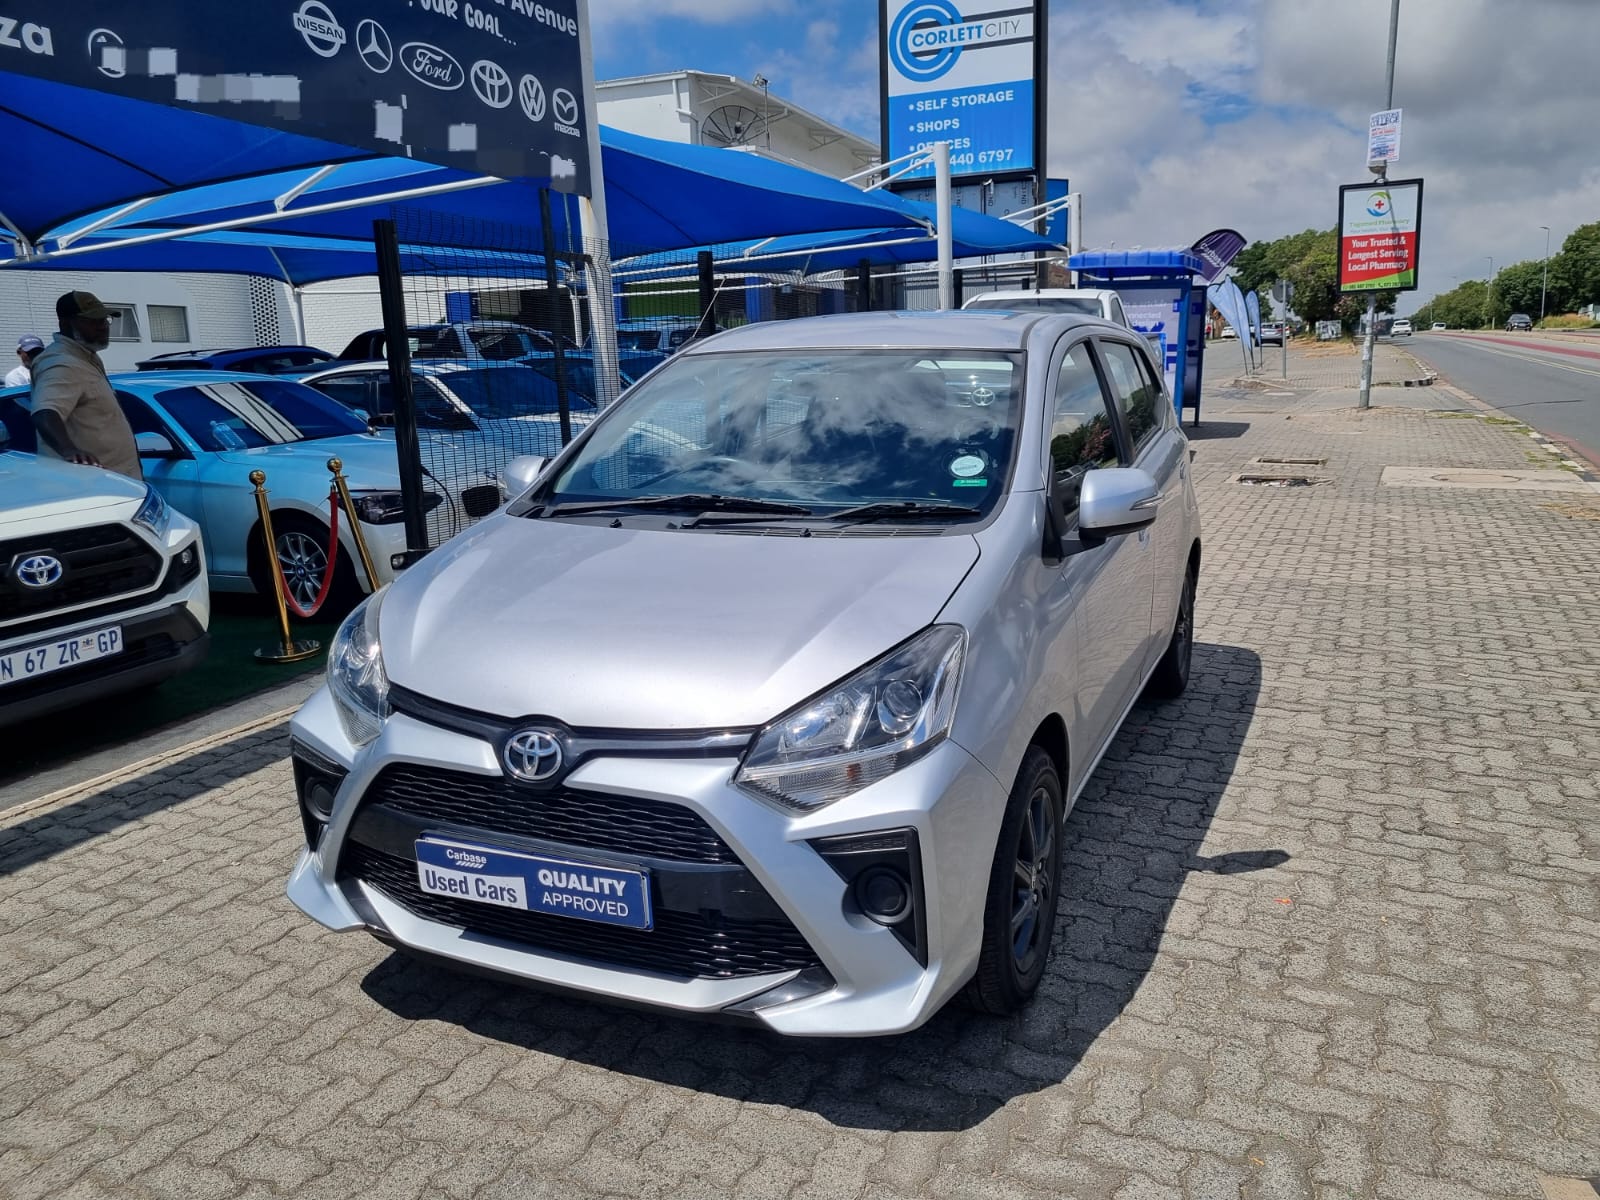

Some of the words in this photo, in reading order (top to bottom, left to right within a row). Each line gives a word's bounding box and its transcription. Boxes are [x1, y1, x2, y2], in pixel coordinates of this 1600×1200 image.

[297, 17, 343, 40] NISSAN
[413, 49, 452, 82] Ford
[916, 98, 948, 112] SELF
[951, 90, 1014, 107] STORAGE
[554, 122, 580, 137] mazda
[916, 118, 960, 133] SHOPS
[978, 148, 1014, 163] 6797
[1352, 239, 1368, 248] Your
[1370, 237, 1398, 247] Trusted
[1400, 236, 1406, 245] &
[1348, 249, 1378, 261] Longest
[1379, 248, 1408, 258] Serving
[1348, 262, 1368, 271] Local
[1369, 260, 1408, 270] Pharmacy
[25, 648, 47, 673] 67
[58, 640, 80, 665] ZR
[97, 629, 118, 654] GP
[446, 849, 487, 864] Carbase
[425, 869, 469, 896] Used
[475, 877, 517, 903] Cars
[538, 868, 626, 897] QUALITY
[542, 891, 629, 917] APPROVED
